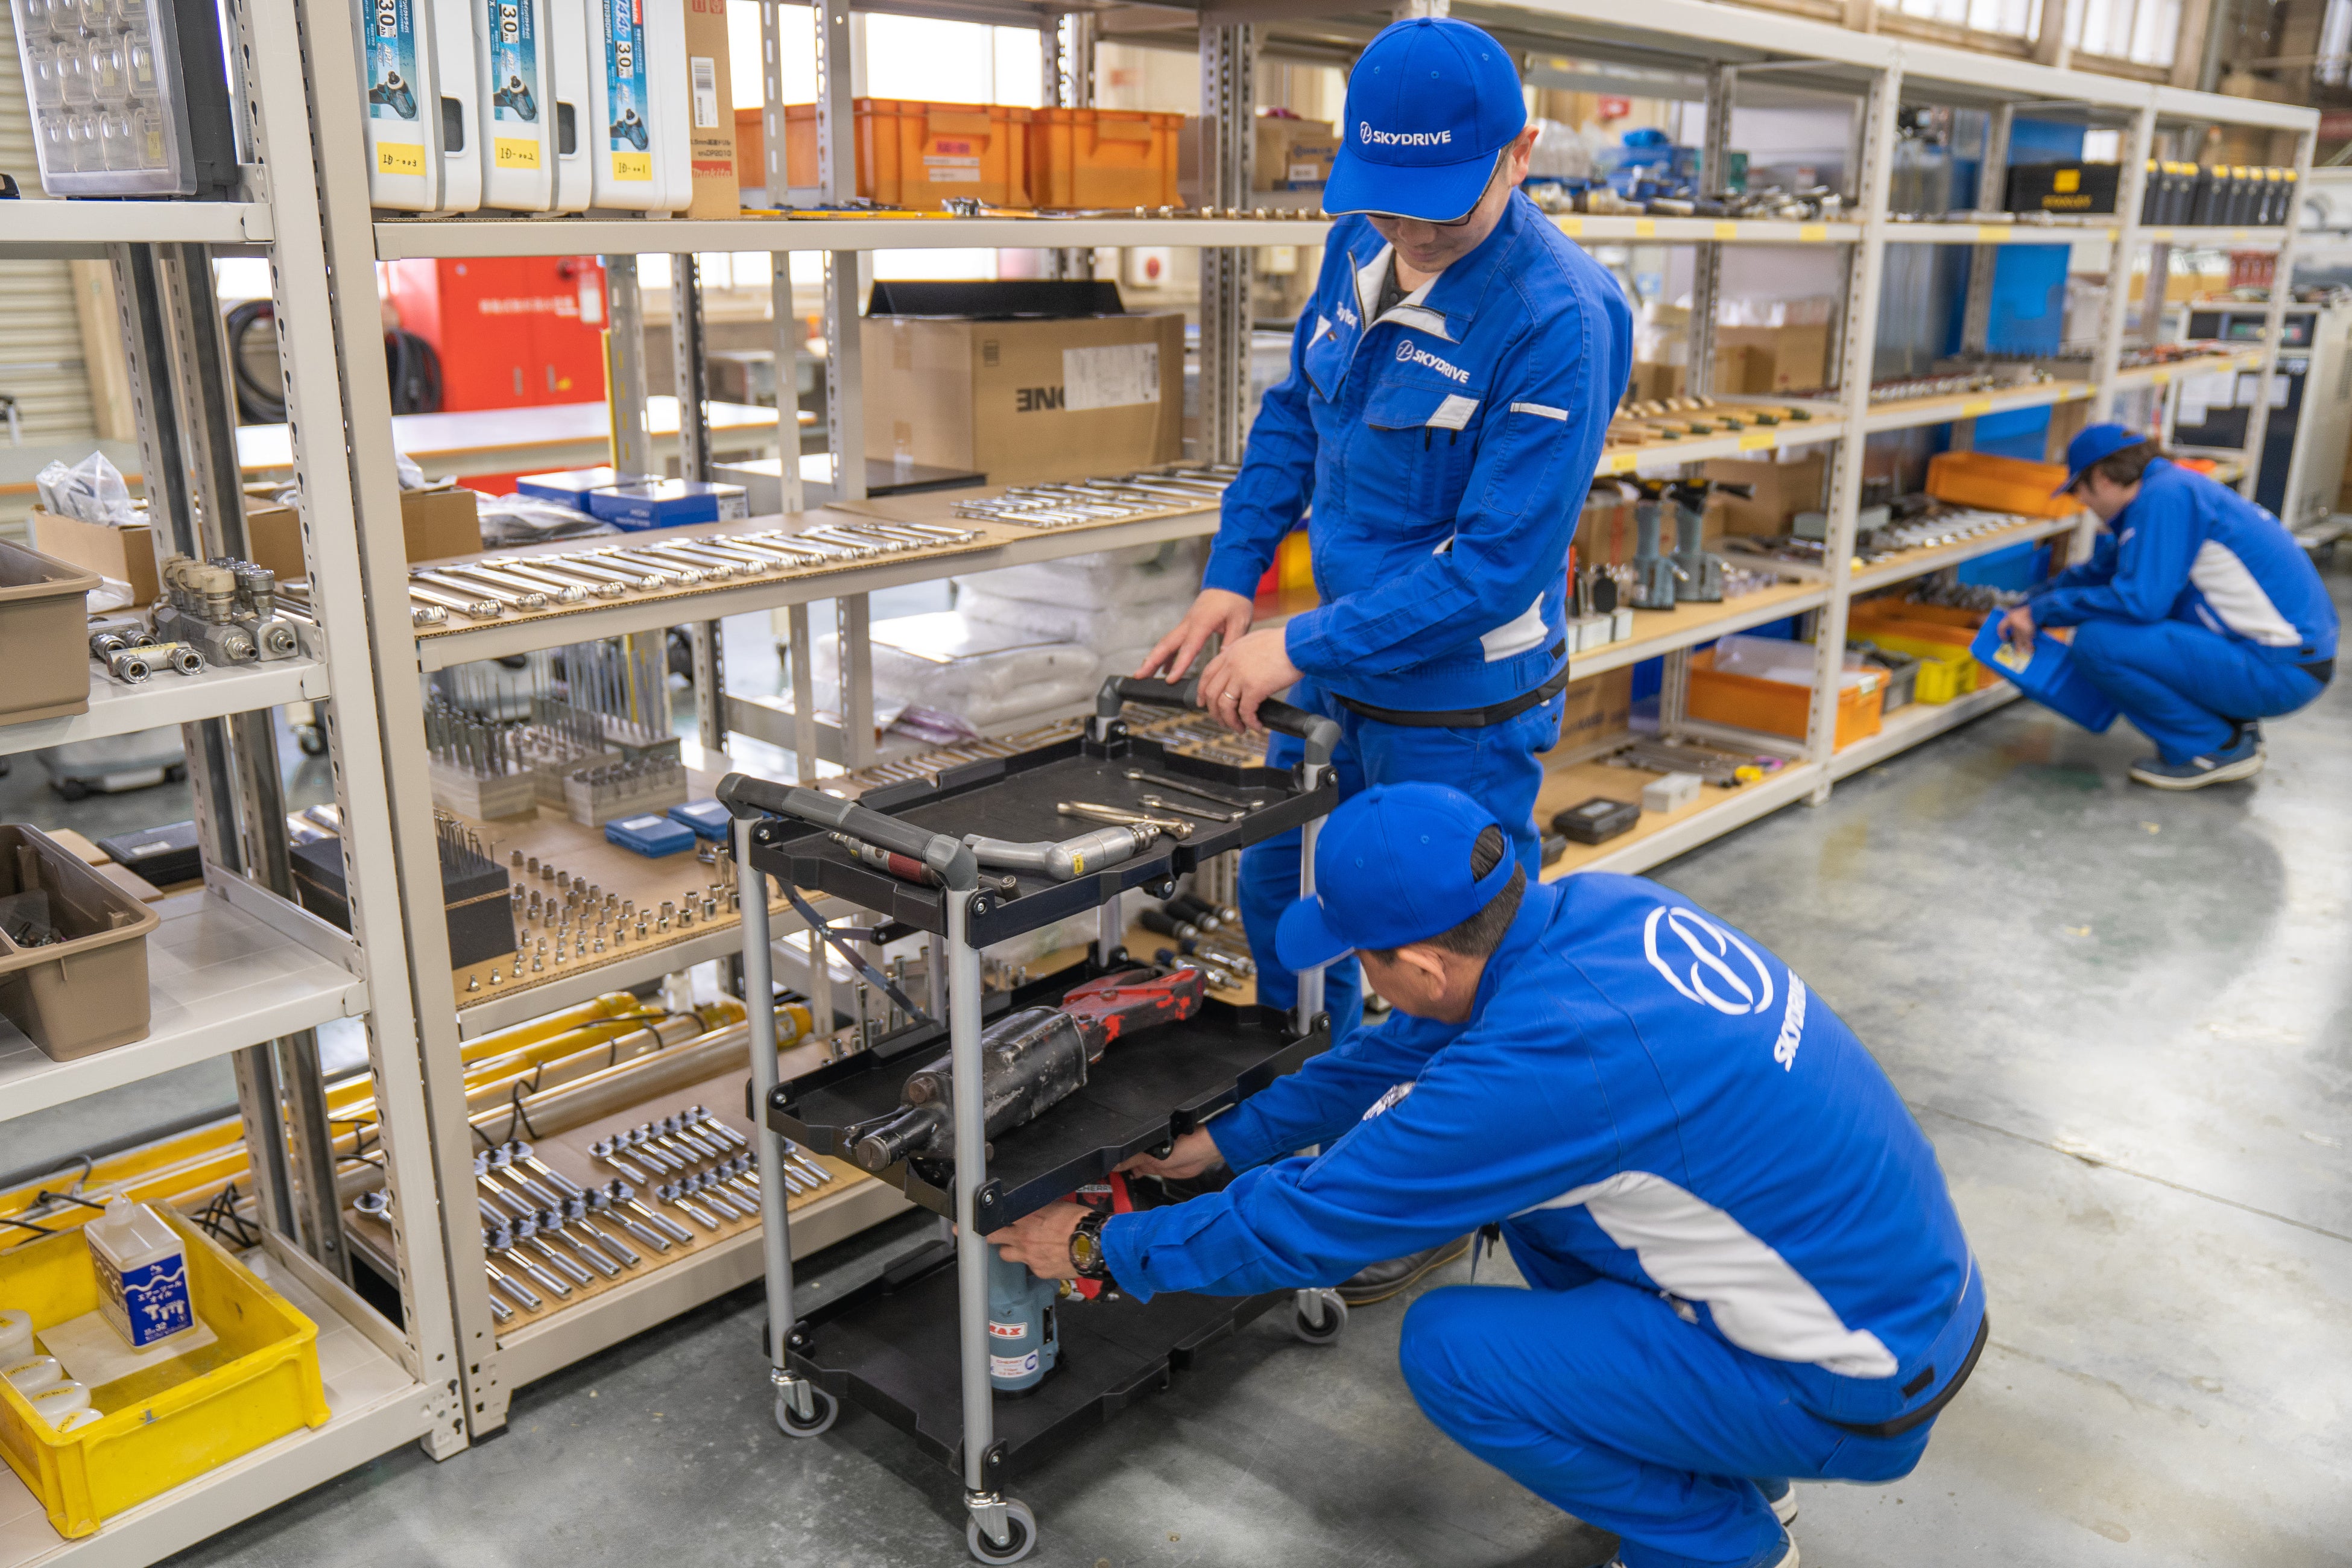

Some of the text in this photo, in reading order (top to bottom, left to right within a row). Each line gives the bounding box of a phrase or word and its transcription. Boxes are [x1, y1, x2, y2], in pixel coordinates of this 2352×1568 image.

[502, 5, 517, 33] 3.0
[380, 26, 387, 36] Ah
[384, 42, 393, 67] APT
[618, 43, 632, 68] 3.0
[1373, 130, 1452, 146] SKYDRIVE
[1412, 349, 1471, 384] SKYDRIVE
[137, 1280, 183, 1302] エアーツール
[149, 1291, 174, 1303] オイル
[155, 1321, 167, 1332] 32
